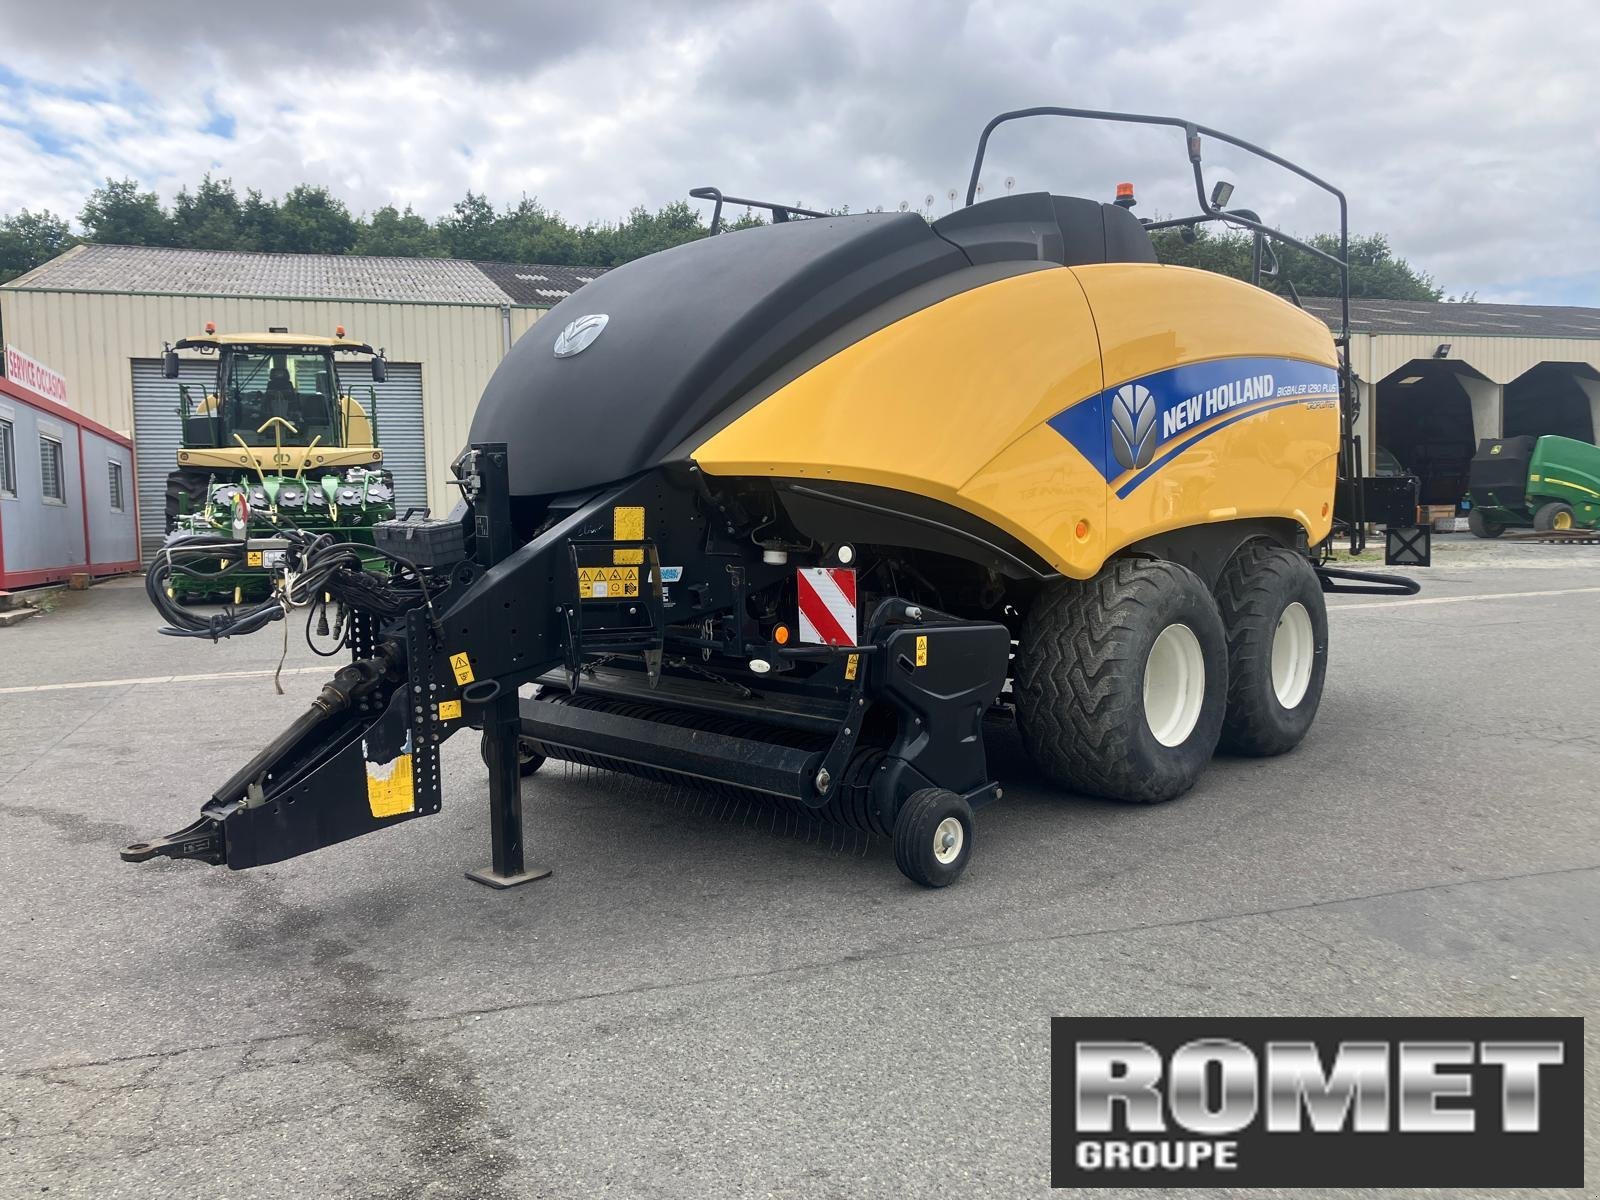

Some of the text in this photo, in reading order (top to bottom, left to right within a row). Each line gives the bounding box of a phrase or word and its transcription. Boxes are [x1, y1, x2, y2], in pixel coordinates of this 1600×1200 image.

[9, 350, 67, 401] SERVICE OCCASION
[1276, 383, 1337, 397] BIGBALER 1290 PLUS
[1163, 374, 1274, 439] NEW HOLLAND
